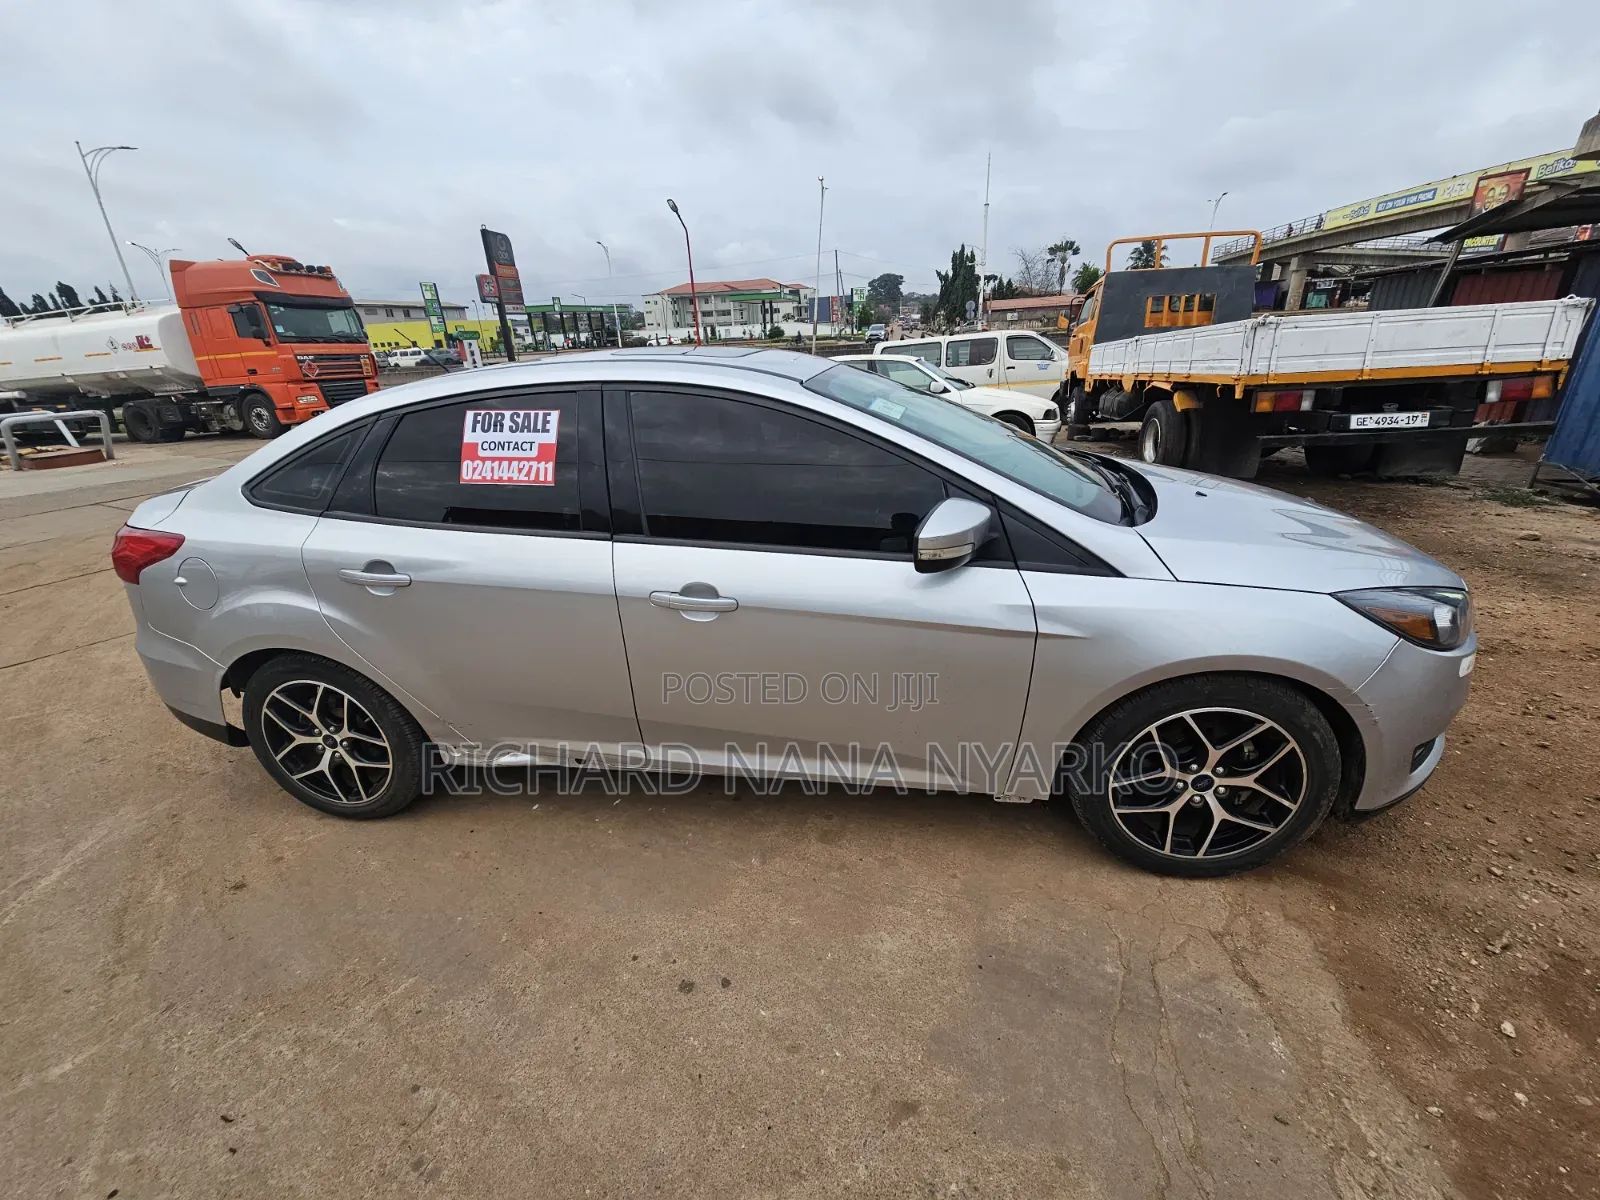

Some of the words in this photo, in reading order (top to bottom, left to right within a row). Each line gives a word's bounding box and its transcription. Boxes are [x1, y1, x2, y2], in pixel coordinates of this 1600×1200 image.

[471, 411, 506, 434] FOR
[508, 411, 552, 434] SALE
[1356, 417, 1369, 427] GE
[480, 441, 535, 452] CONTACT
[461, 459, 554, 482] 0241442711
